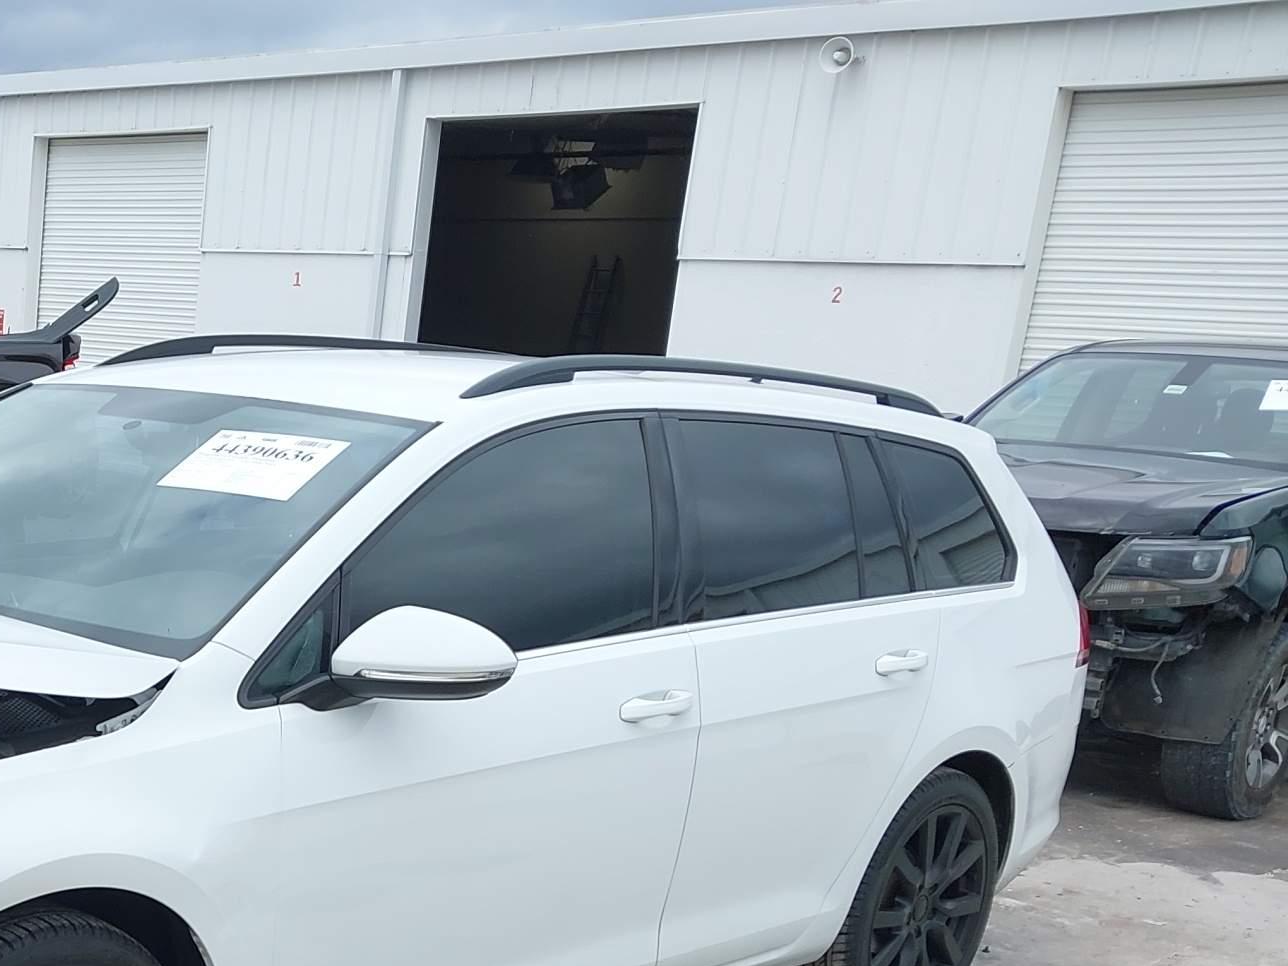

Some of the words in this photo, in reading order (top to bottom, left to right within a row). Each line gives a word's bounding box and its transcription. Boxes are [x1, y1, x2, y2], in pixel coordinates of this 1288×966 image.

[292, 272, 301, 287] 1
[831, 286, 842, 304] 2
[212, 443, 318, 463] 44390636
